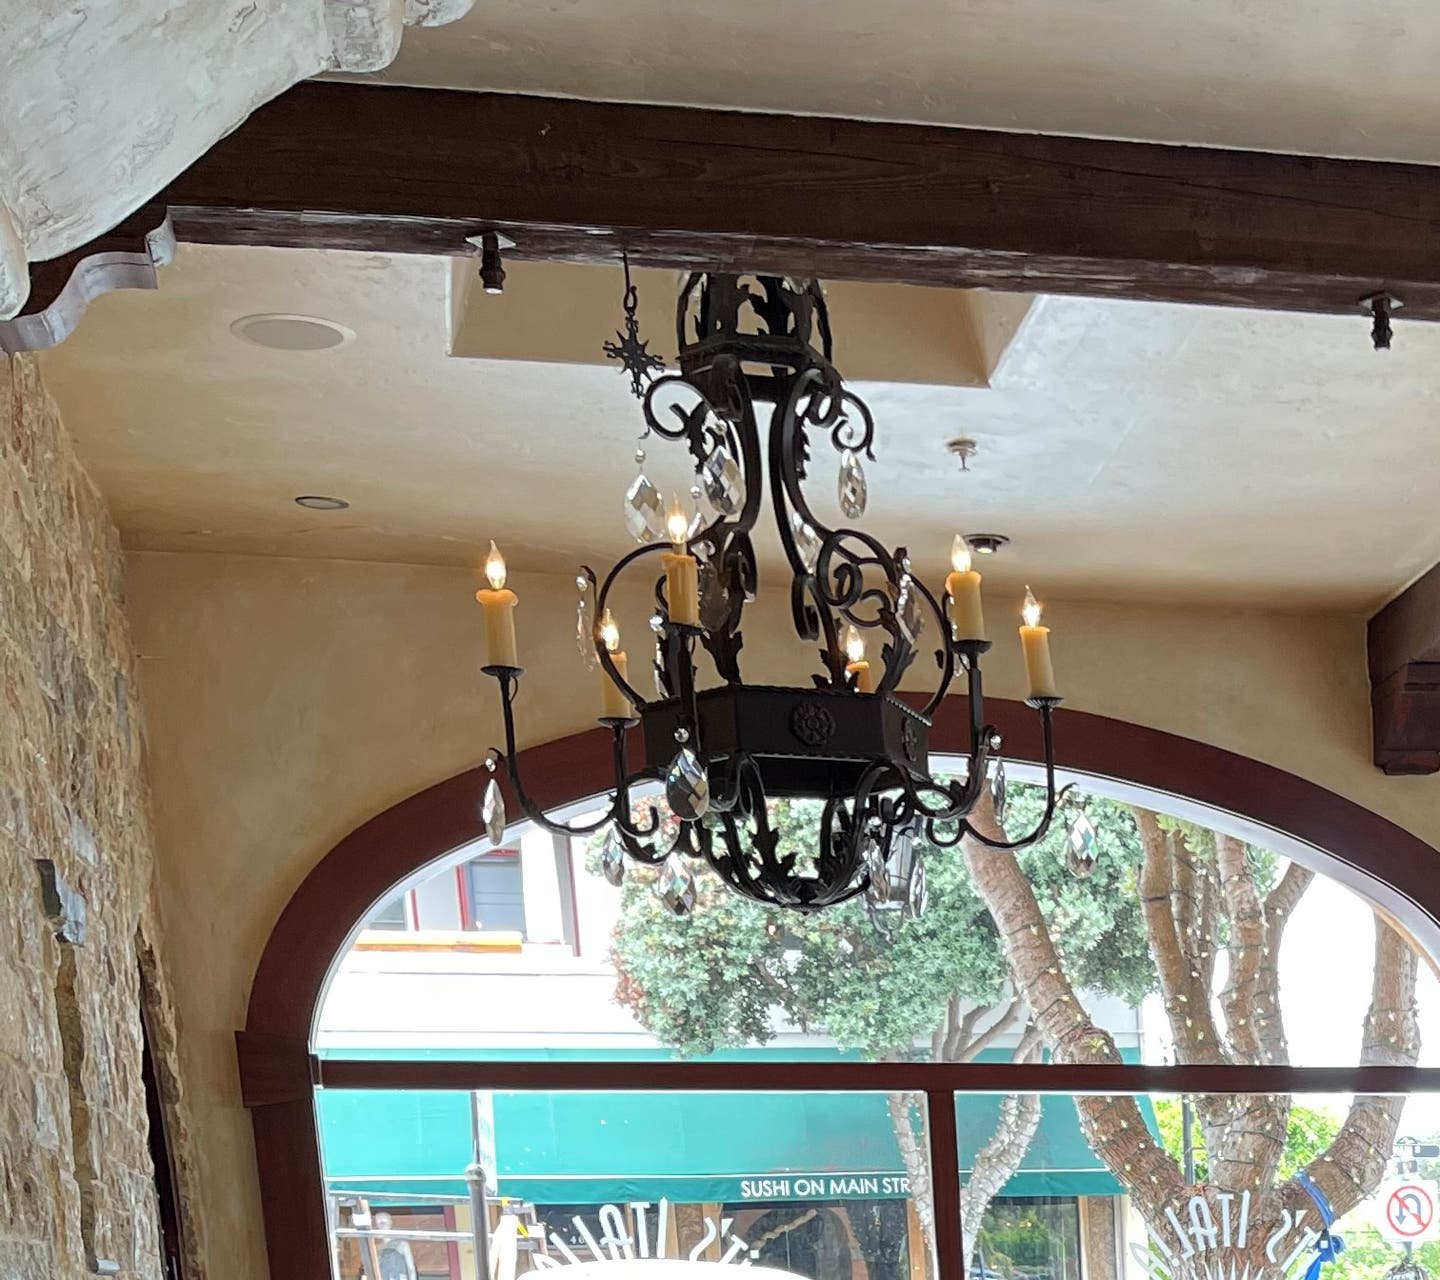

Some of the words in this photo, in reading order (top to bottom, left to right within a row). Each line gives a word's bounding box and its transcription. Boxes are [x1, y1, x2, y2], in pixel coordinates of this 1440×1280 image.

[741, 1180, 790, 1198] SUSHI
[794, 1178, 825, 1196] ON
[830, 1177, 878, 1195] MAIN
[882, 1177, 912, 1194] STR
